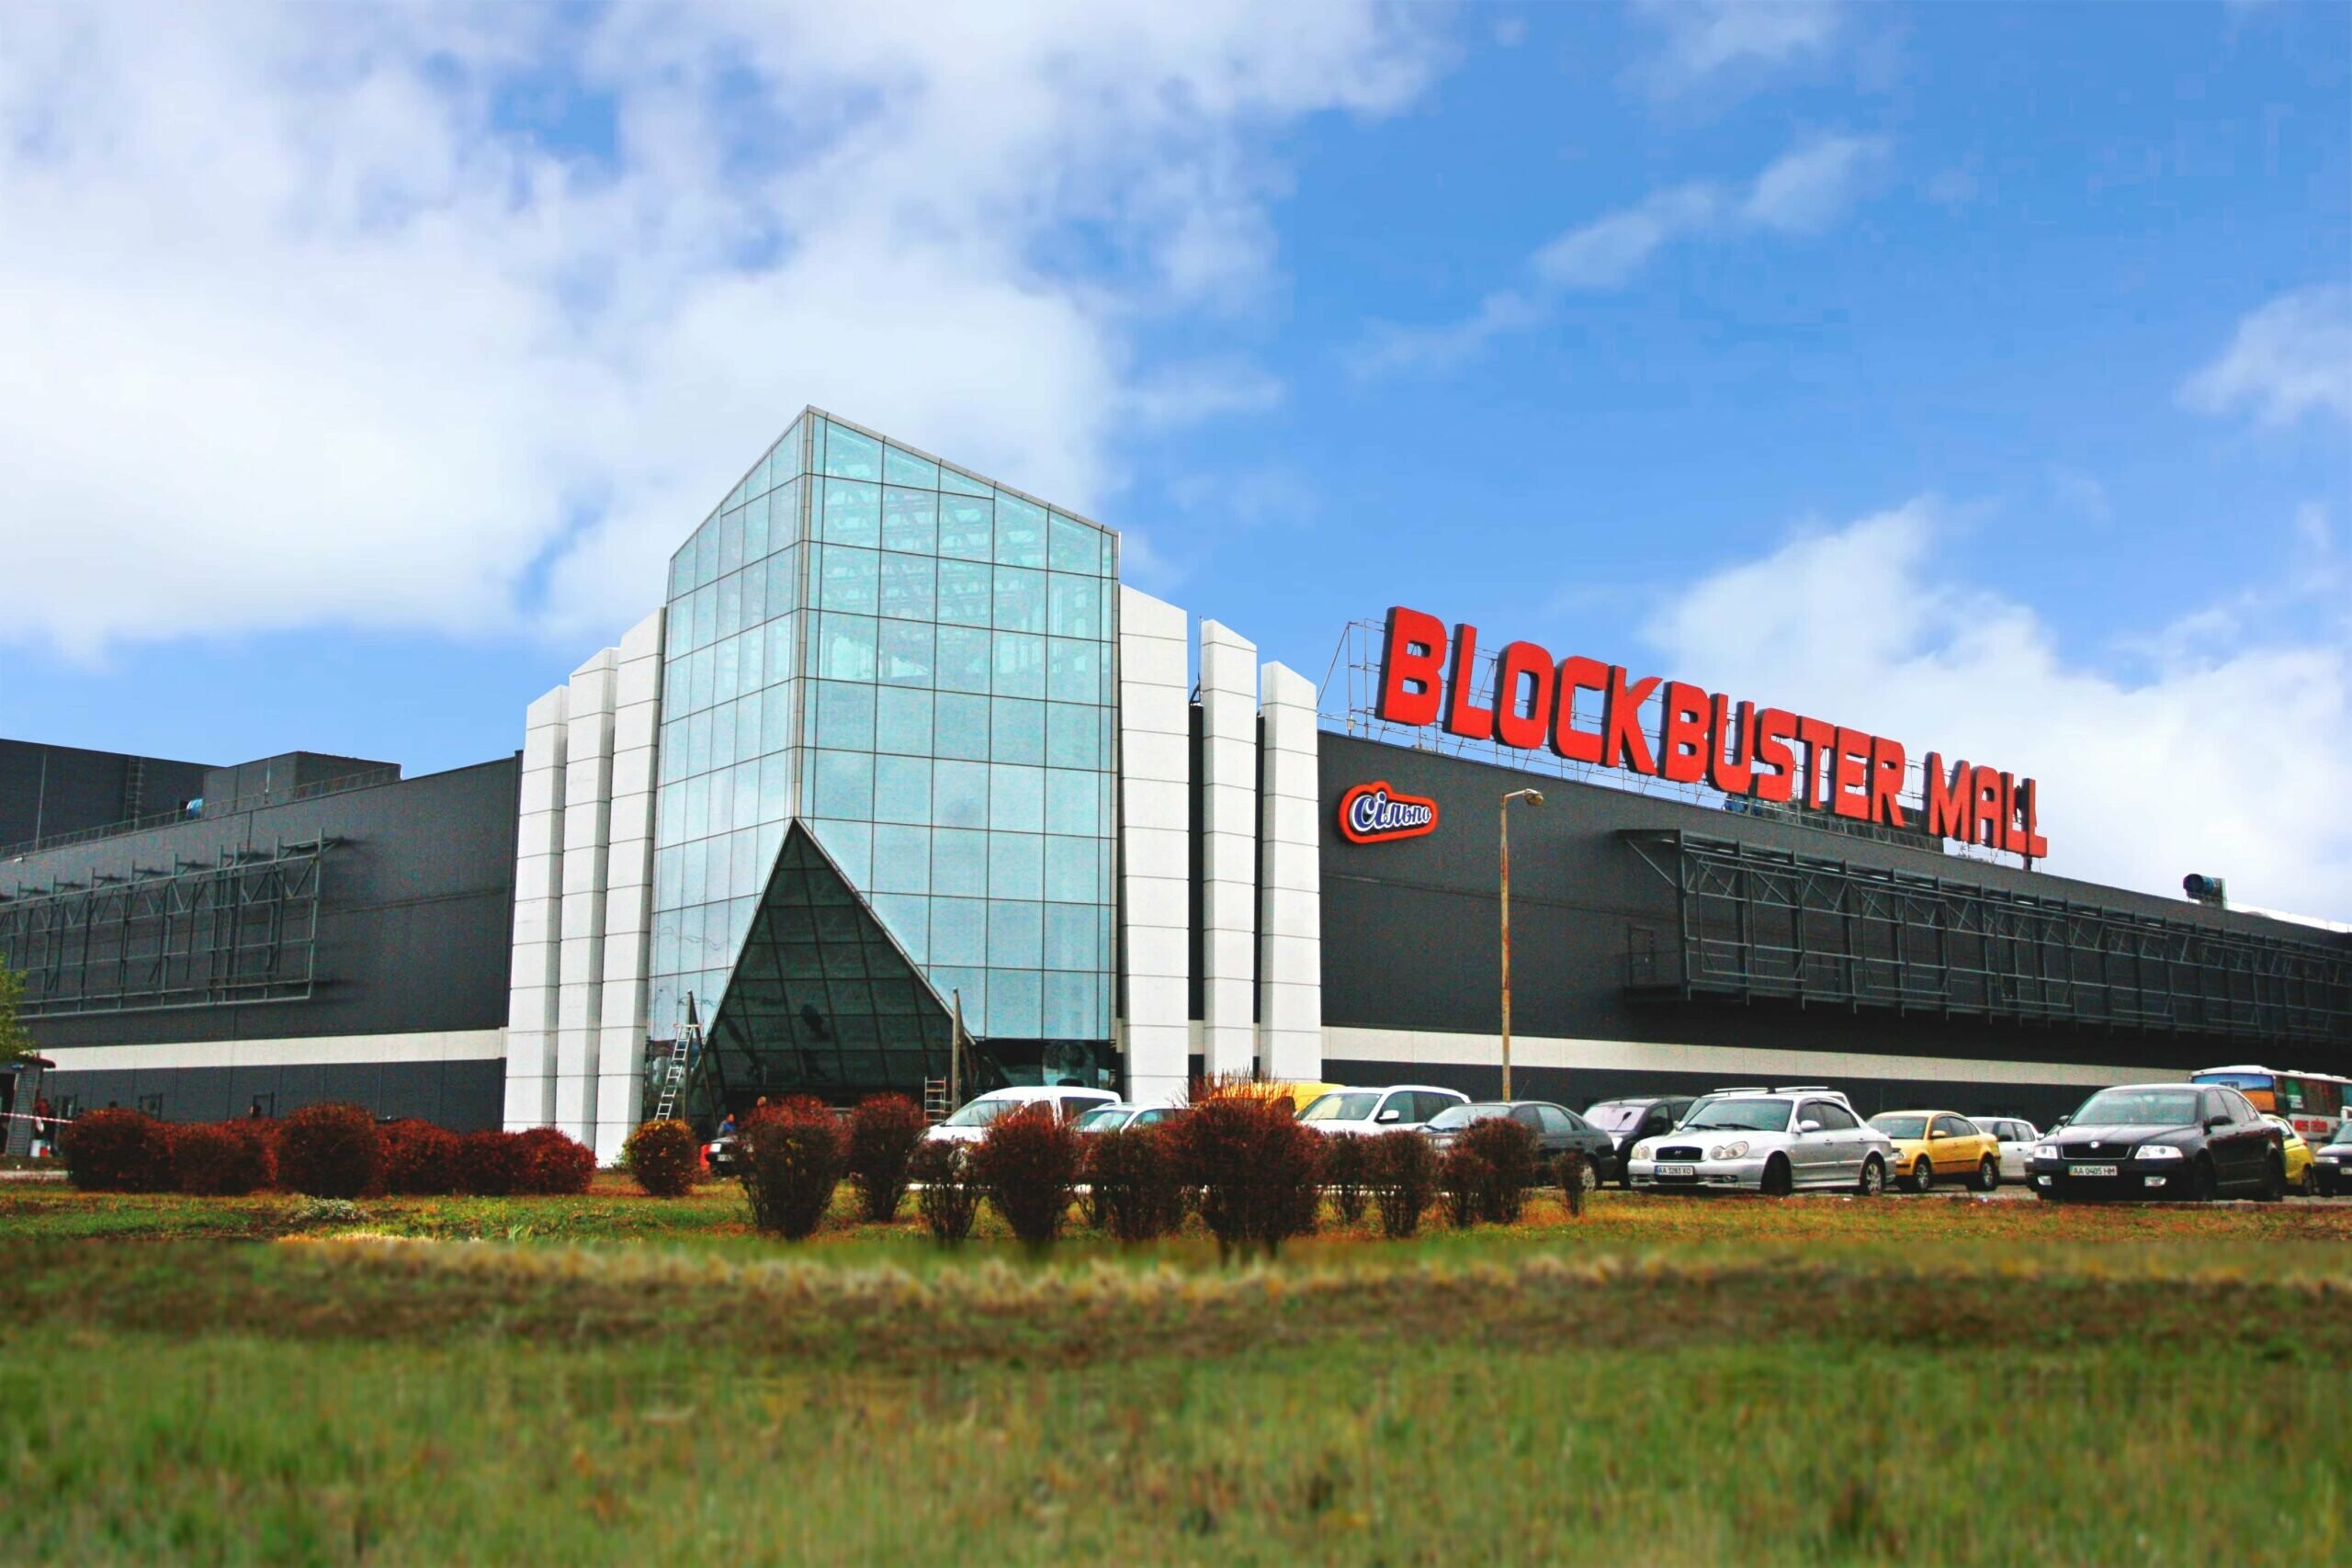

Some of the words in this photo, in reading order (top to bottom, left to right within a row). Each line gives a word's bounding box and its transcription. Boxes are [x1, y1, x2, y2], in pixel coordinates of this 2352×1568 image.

[1374, 605, 1905, 828] BLOCKBUSTER
[1924, 751, 2047, 858] MALL
[1349, 791, 1431, 831] Сільпо
[2073, 1167, 2084, 1175] AA
